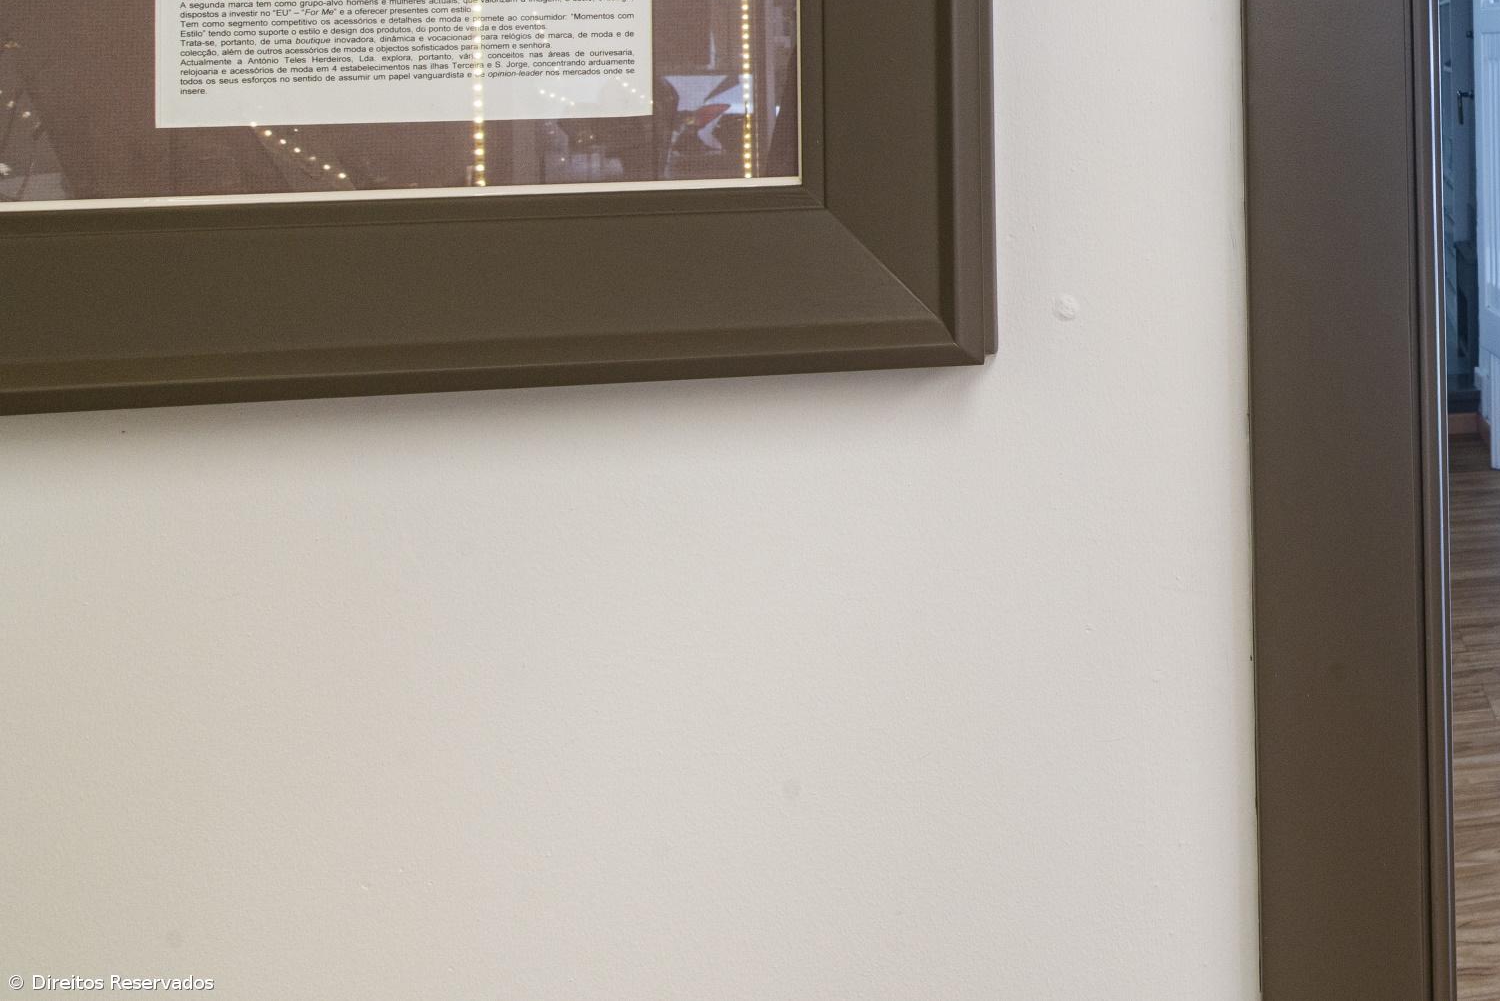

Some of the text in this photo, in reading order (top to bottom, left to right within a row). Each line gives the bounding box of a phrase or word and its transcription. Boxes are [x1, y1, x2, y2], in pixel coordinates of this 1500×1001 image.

[258, 27, 289, 37] suporte
[329, 26, 357, 35] design
[428, 24, 451, 33] ponto
[284, 46, 329, 54] acessórios
[375, 44, 409, 53] objectos
[411, 43, 459, 51] sofisticados
